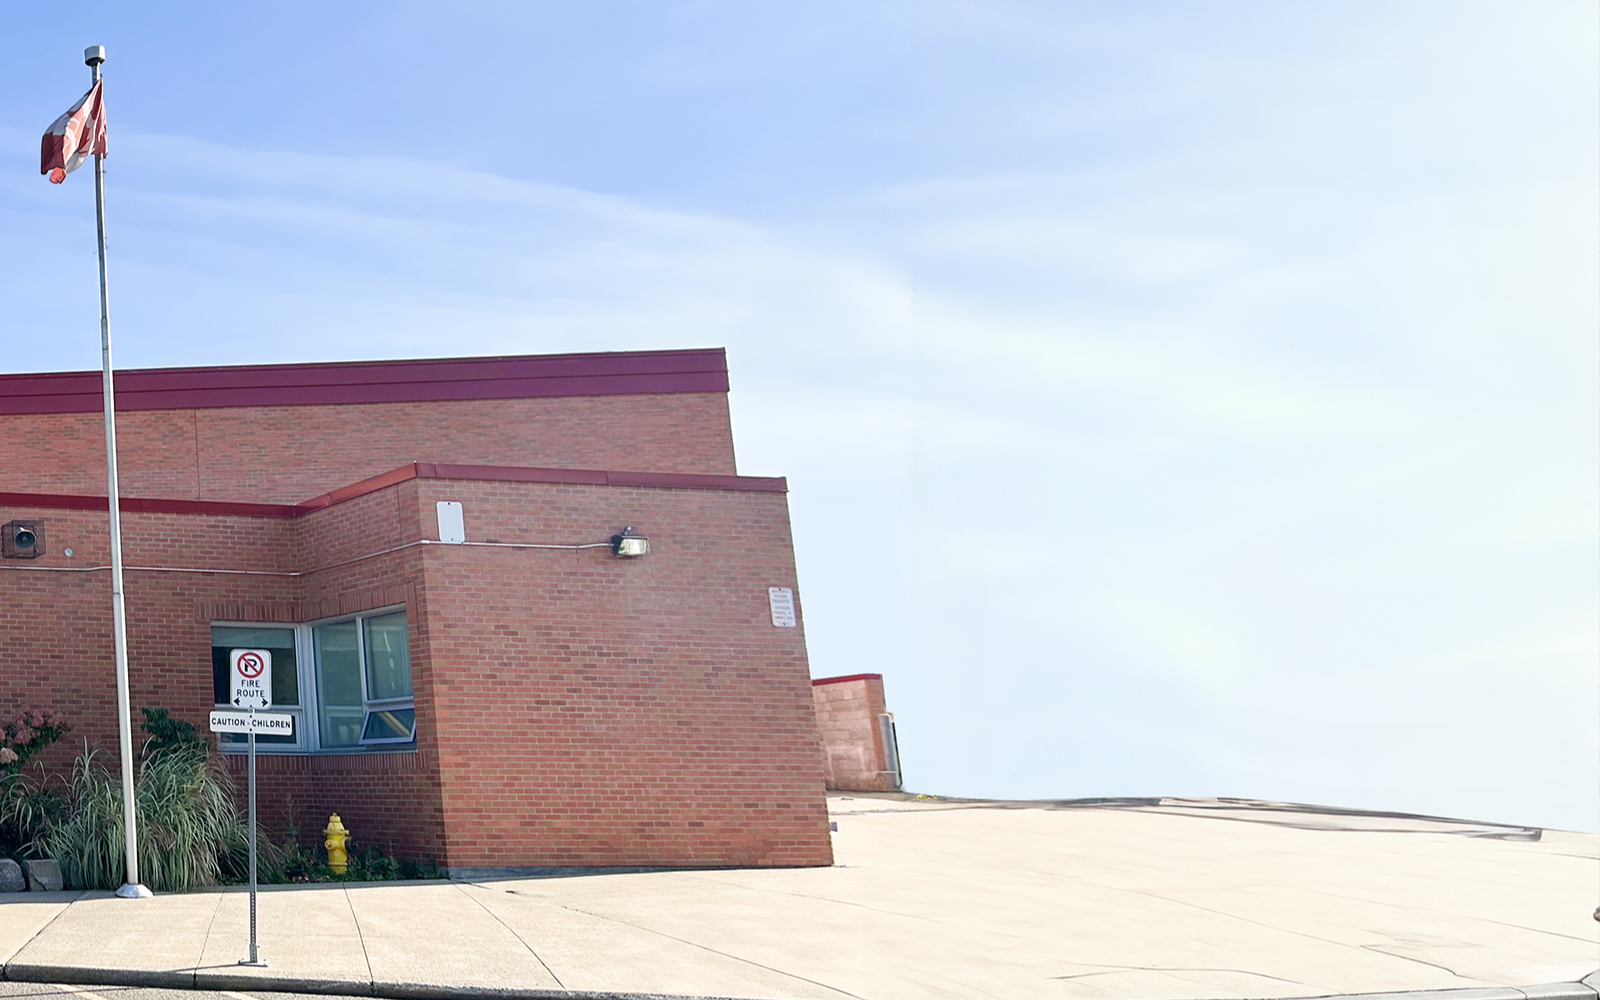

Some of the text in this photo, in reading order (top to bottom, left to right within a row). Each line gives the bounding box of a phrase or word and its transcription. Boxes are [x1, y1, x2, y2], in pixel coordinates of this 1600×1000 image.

[241, 679, 261, 688] FIRE
[236, 689, 266, 698] ROUTE
[211, 717, 246, 727] CAUTION
[251, 719, 291, 729] CHILDREN
